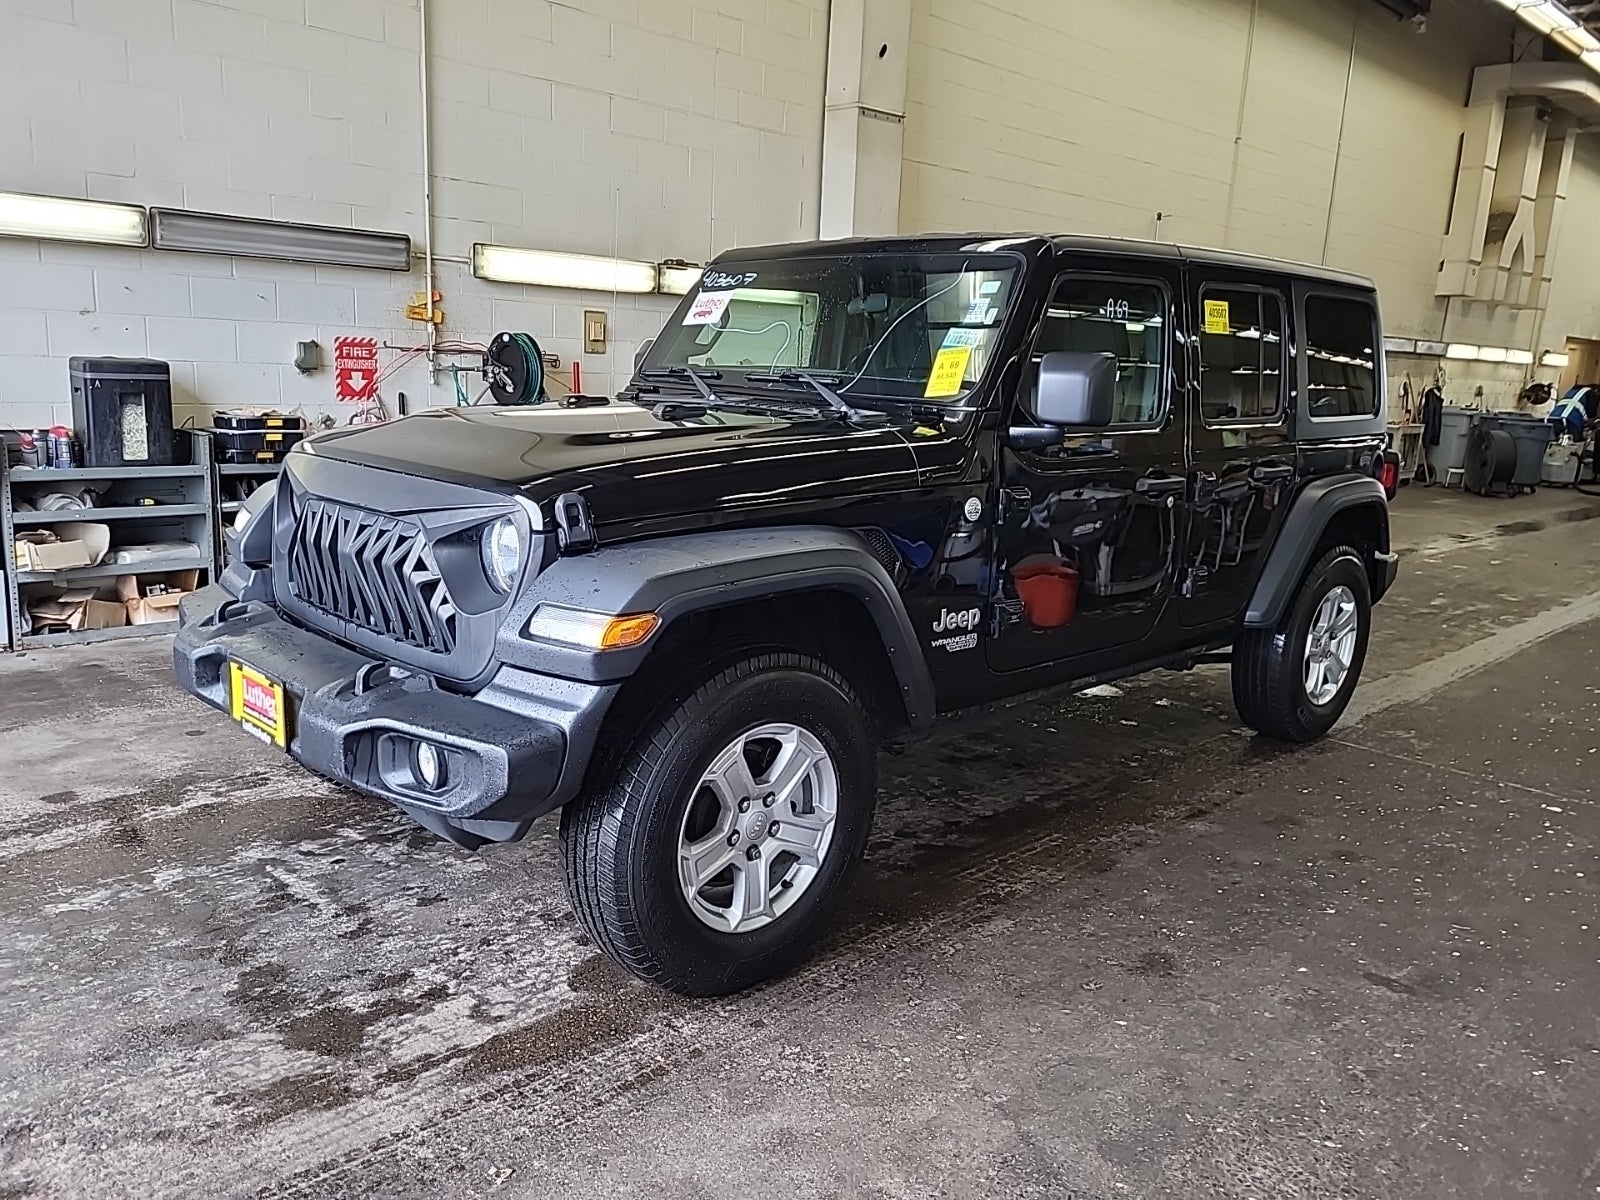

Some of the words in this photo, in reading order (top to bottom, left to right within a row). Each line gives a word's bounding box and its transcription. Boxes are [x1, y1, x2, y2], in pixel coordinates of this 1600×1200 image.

[703, 271, 758, 287] 403607
[695, 297, 726, 310] Luther
[1107, 298, 1114, 318] A
[1117, 299, 1129, 318] 69
[342, 346, 371, 357] FIRE
[337, 359, 376, 370] EXTINGUISHER
[938, 362, 945, 370] A
[949, 361, 960, 369] 69
[932, 608, 981, 633] Jeep
[931, 633, 978, 647] WRANGLER
[243, 678, 276, 720] Luther
